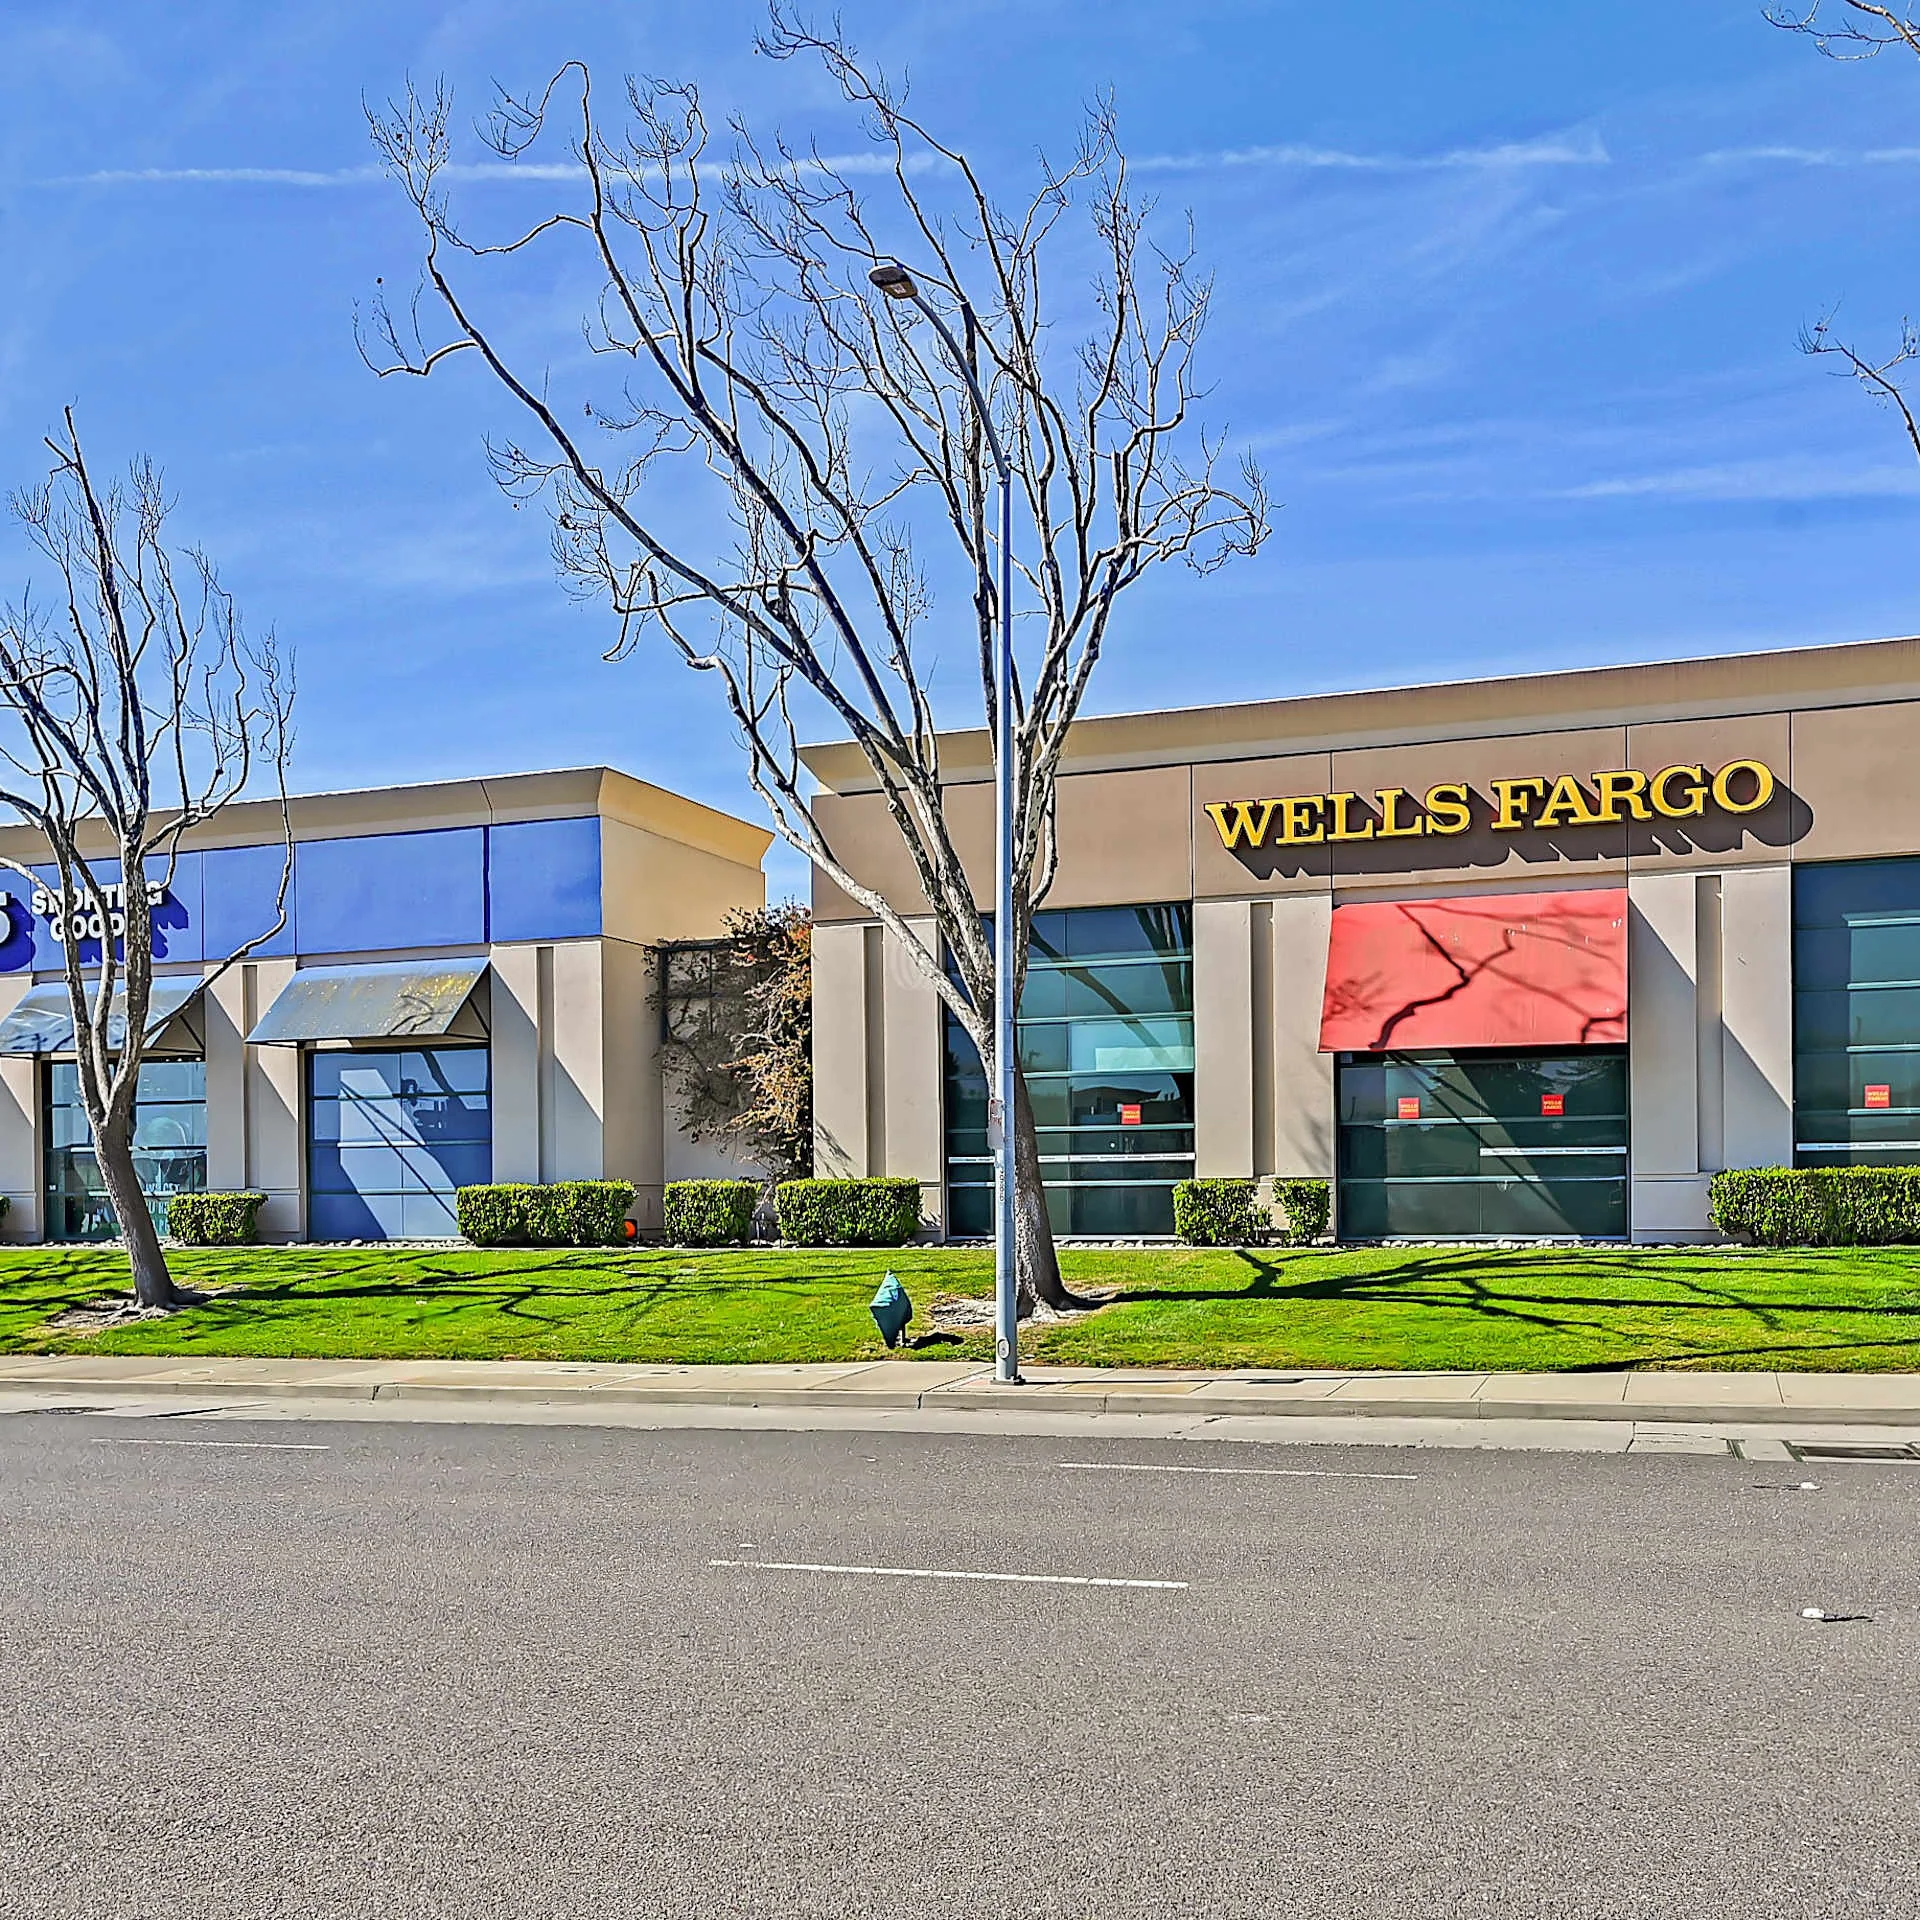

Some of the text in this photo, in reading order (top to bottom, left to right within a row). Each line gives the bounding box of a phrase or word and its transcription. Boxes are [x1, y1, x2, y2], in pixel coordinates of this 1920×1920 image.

[1203, 758, 1775, 850] WELLS FARGO
[50, 912, 127, 942] GOOD
